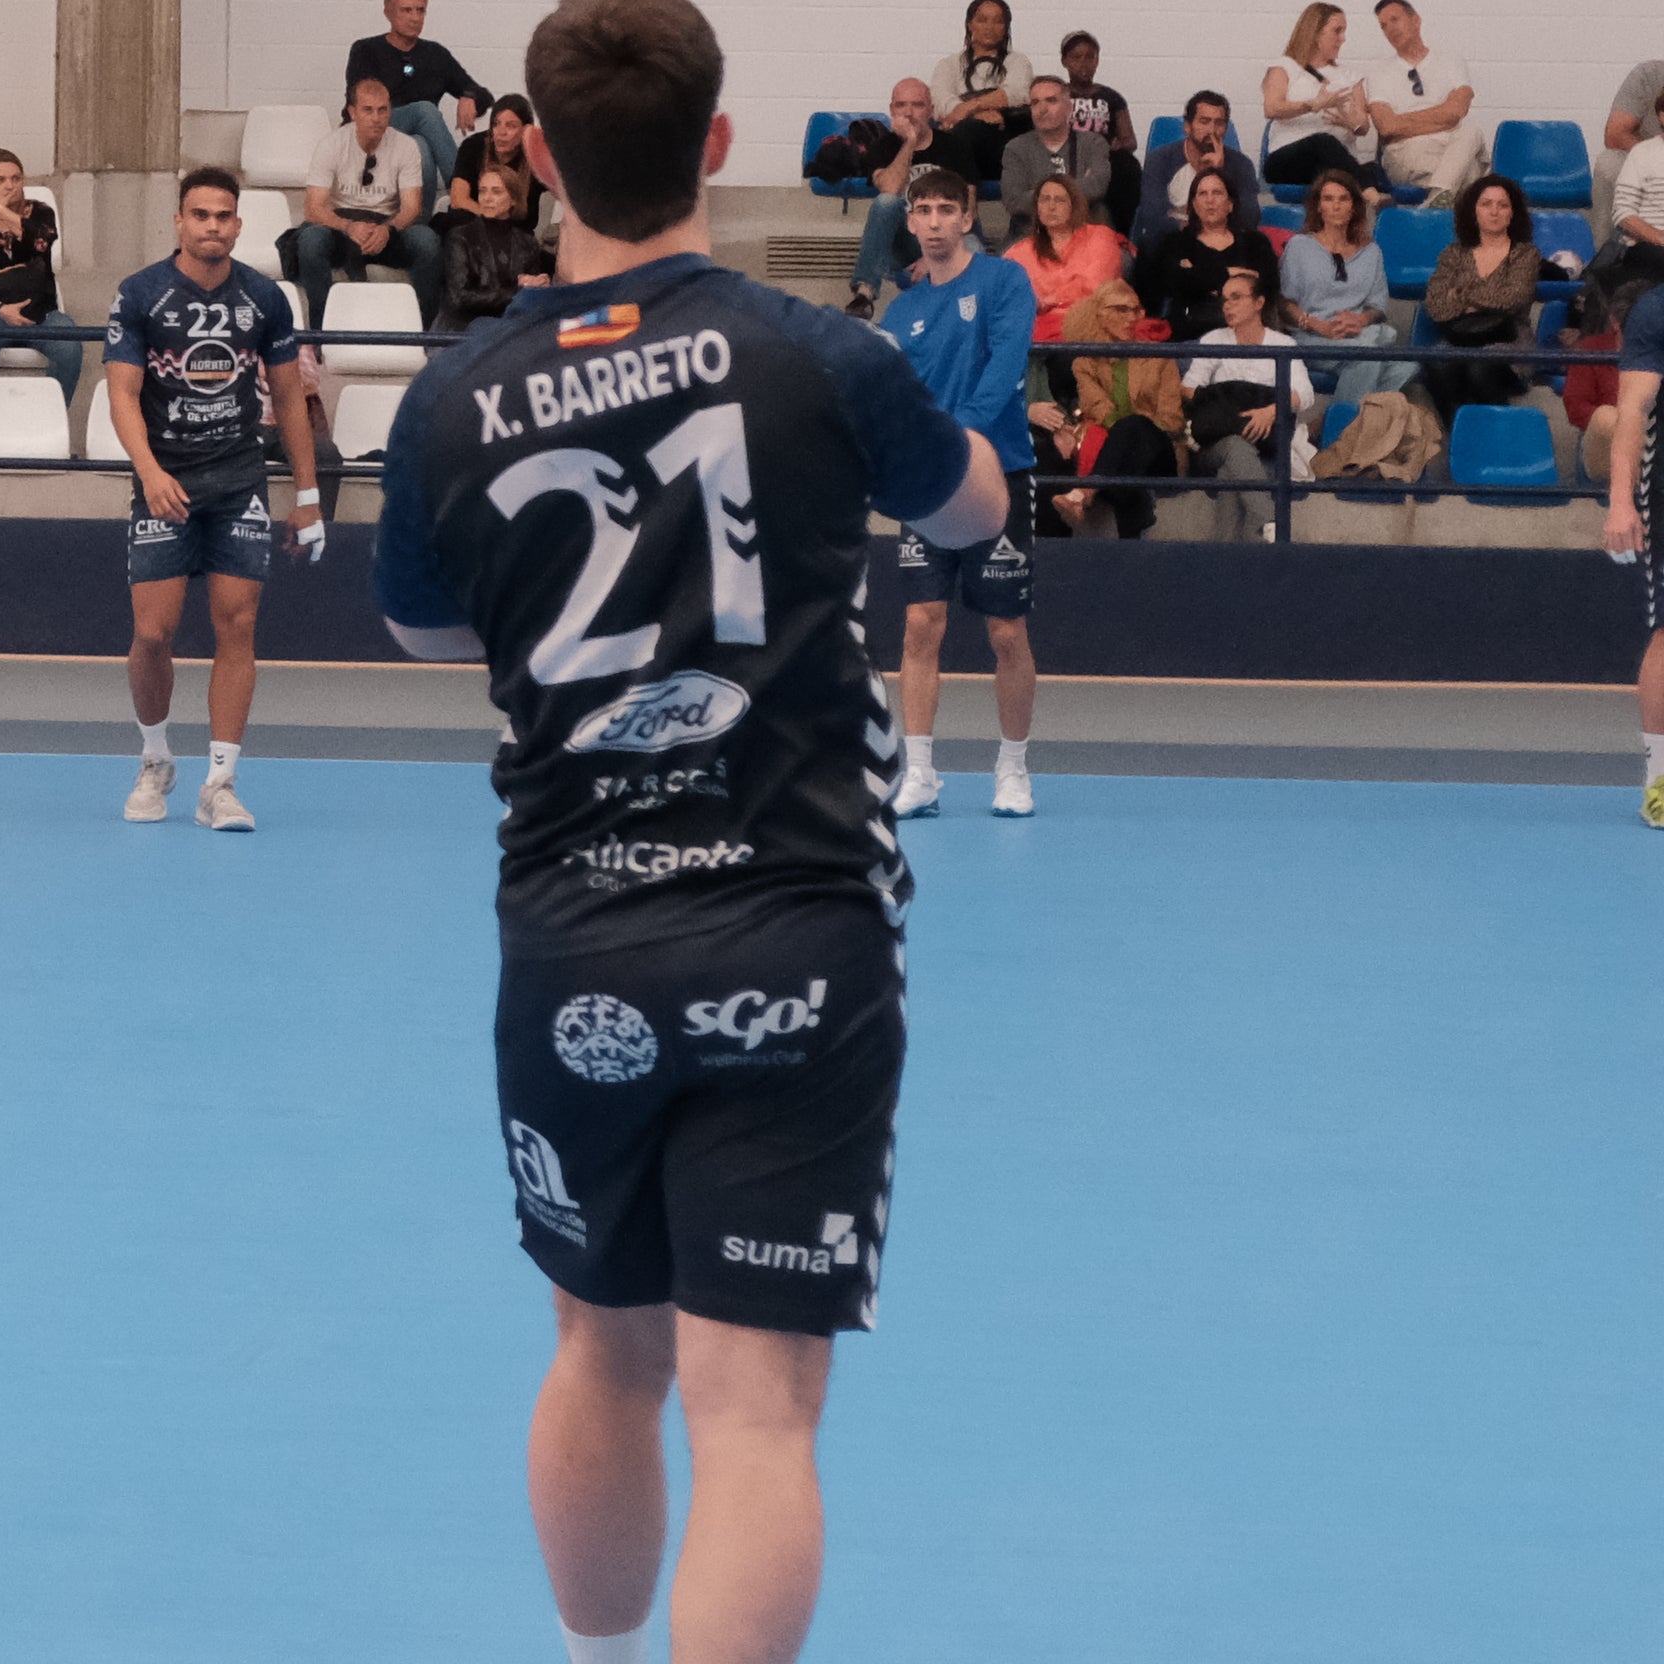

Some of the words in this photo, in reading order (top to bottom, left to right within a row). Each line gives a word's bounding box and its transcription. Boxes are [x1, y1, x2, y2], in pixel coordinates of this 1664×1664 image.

[186, 302, 233, 338] 22
[473, 386, 522, 445] X.
[527, 329, 732, 429] BARRETO
[486, 403, 767, 686] 21
[898, 543, 926, 558] RC
[722, 1235, 831, 1275] suma
